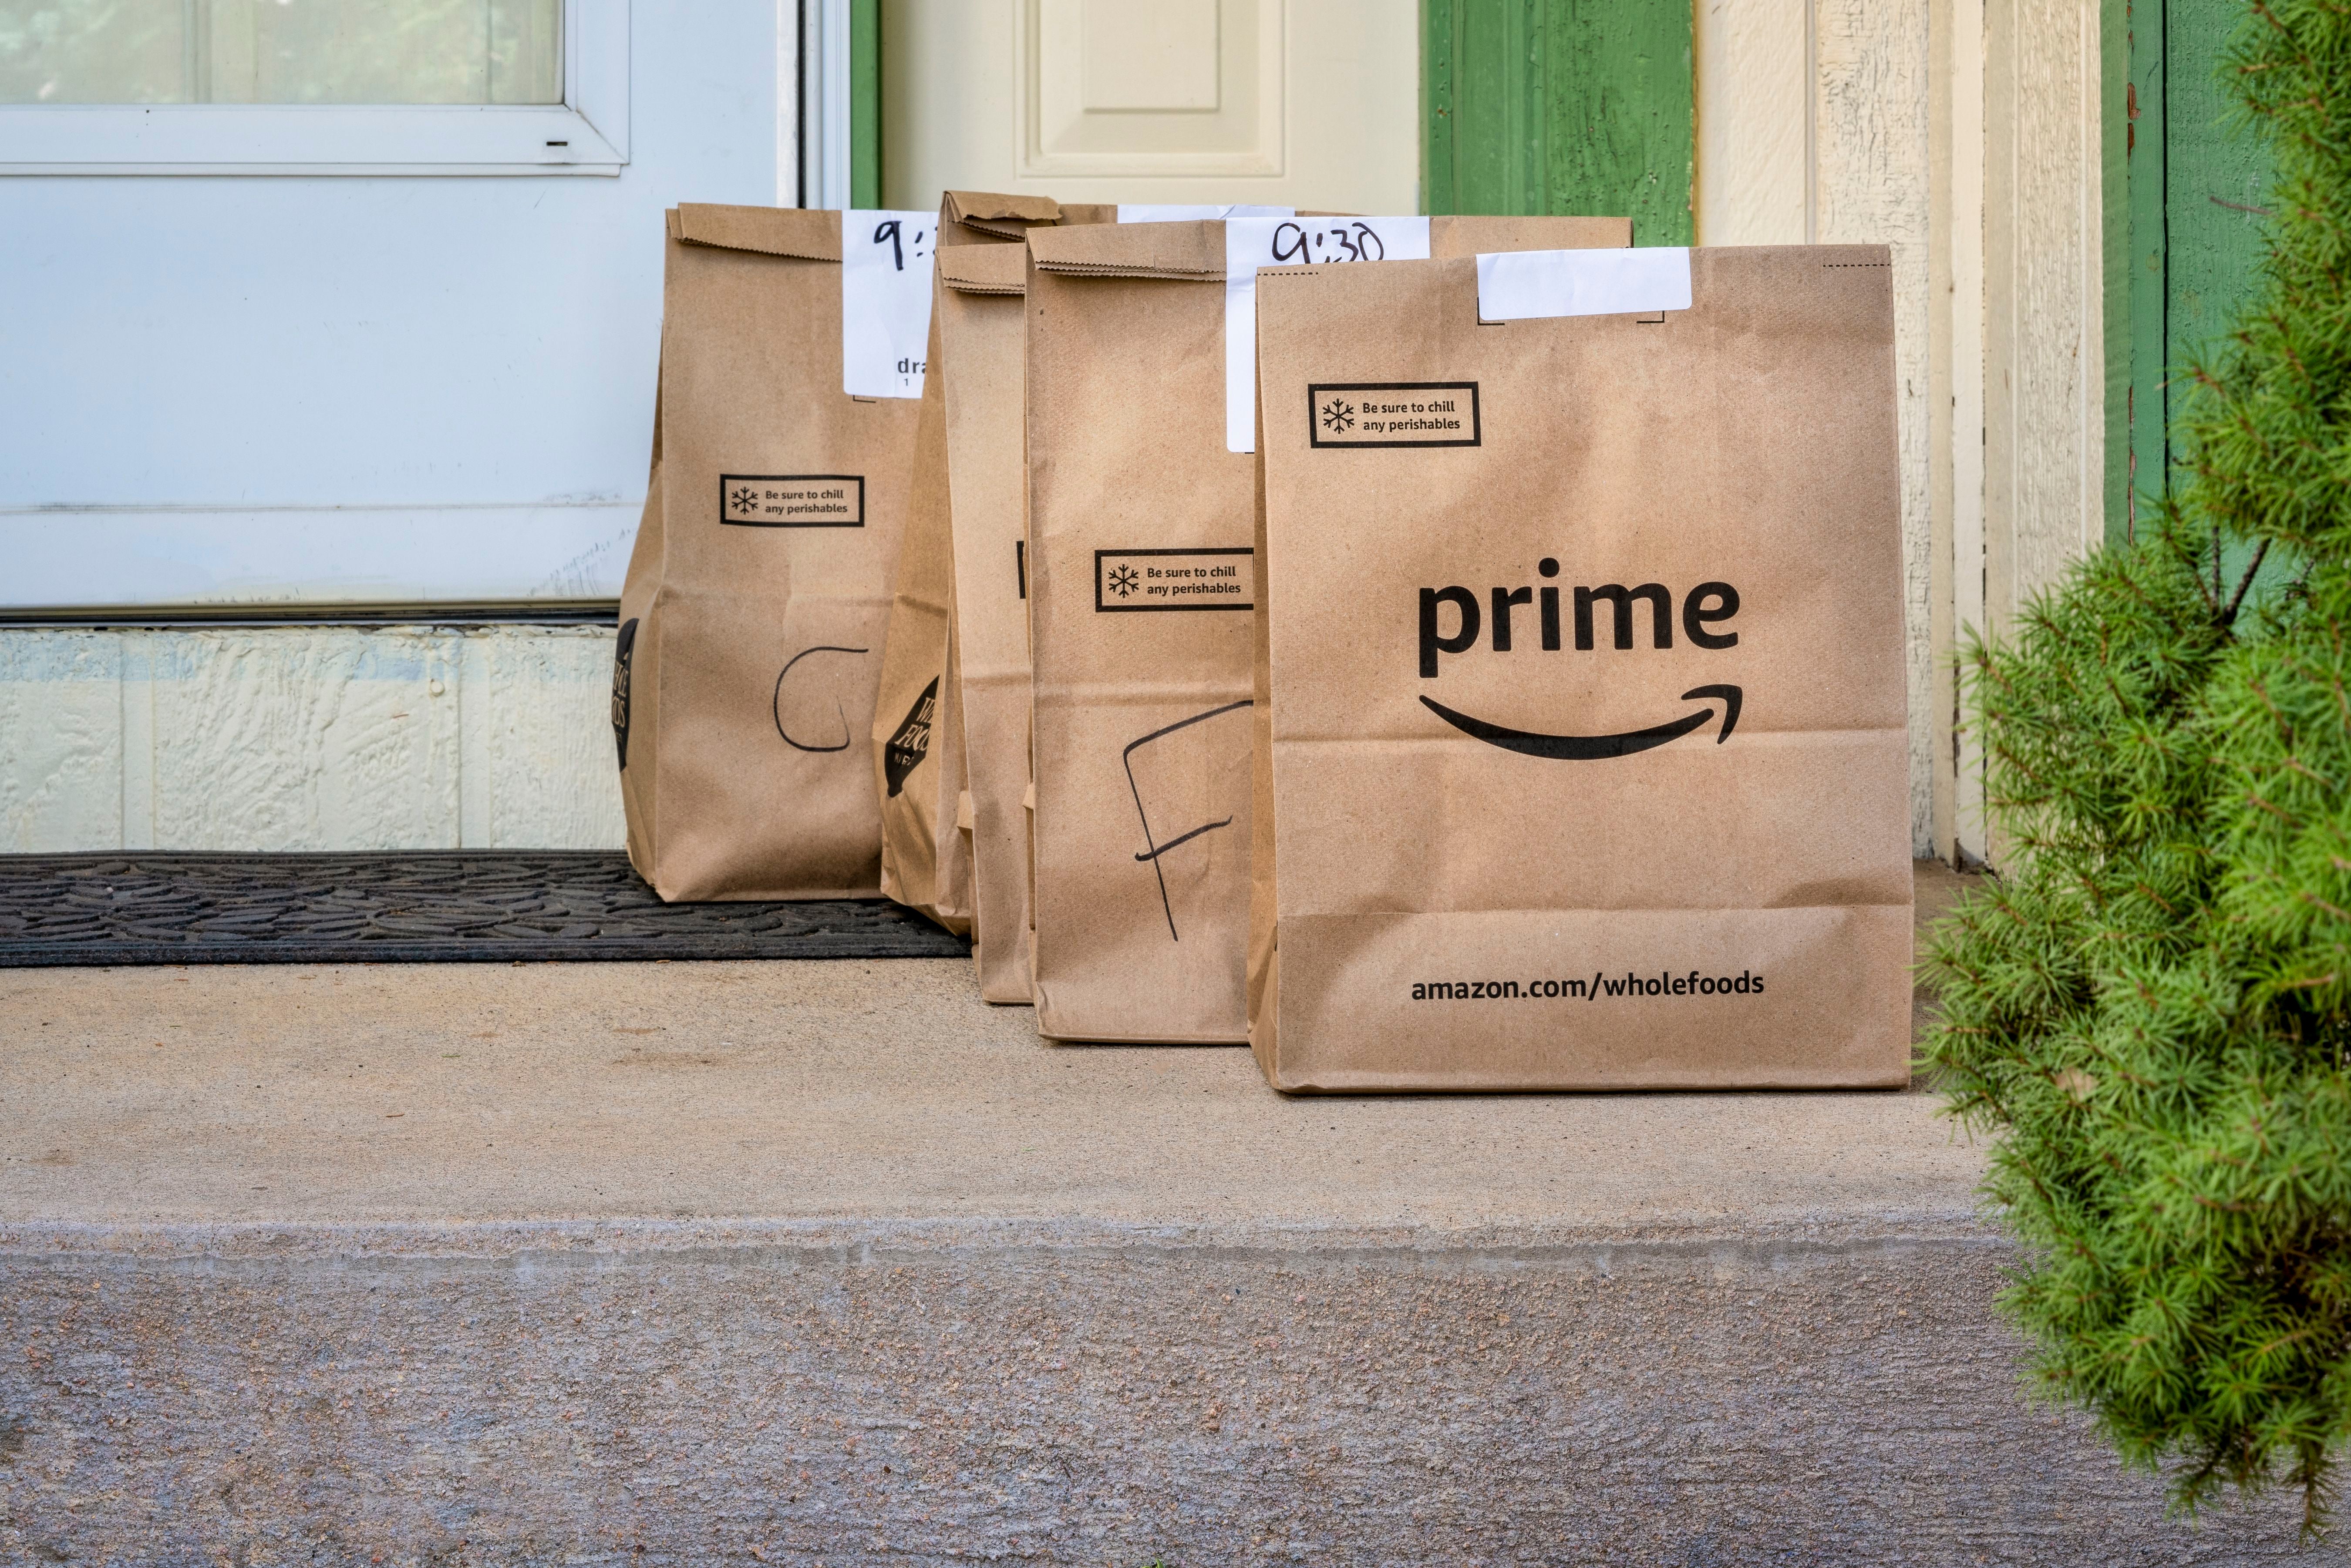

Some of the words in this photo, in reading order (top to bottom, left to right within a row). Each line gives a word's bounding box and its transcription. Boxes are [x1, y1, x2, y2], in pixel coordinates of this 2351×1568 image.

[873, 220, 938, 271] 9:
[1272, 222, 1384, 264] 9:30
[1362, 402, 1378, 414] Be
[1381, 404, 1408, 414] sure
[1410, 402, 1425, 413] to
[1428, 400, 1455, 413] chill
[1363, 421, 1386, 434] any
[1388, 417, 1461, 433] perishables
[765, 490, 779, 500] Be
[806, 490, 818, 499] to
[820, 489, 844, 499] chill
[765, 505, 785, 516] any
[787, 503, 848, 516] perishables
[1147, 567, 1162, 579] Be
[1165, 569, 1191, 578] sure
[1193, 567, 1207, 578] to
[1209, 565, 1237, 578] chill
[1147, 585, 1169, 597] any
[1172, 582, 1241, 597] perishables
[1418, 557, 1740, 678] prime
[1123, 699, 1254, 942] F
[1411, 970, 1765, 1001] amazon.com/wholefoods
